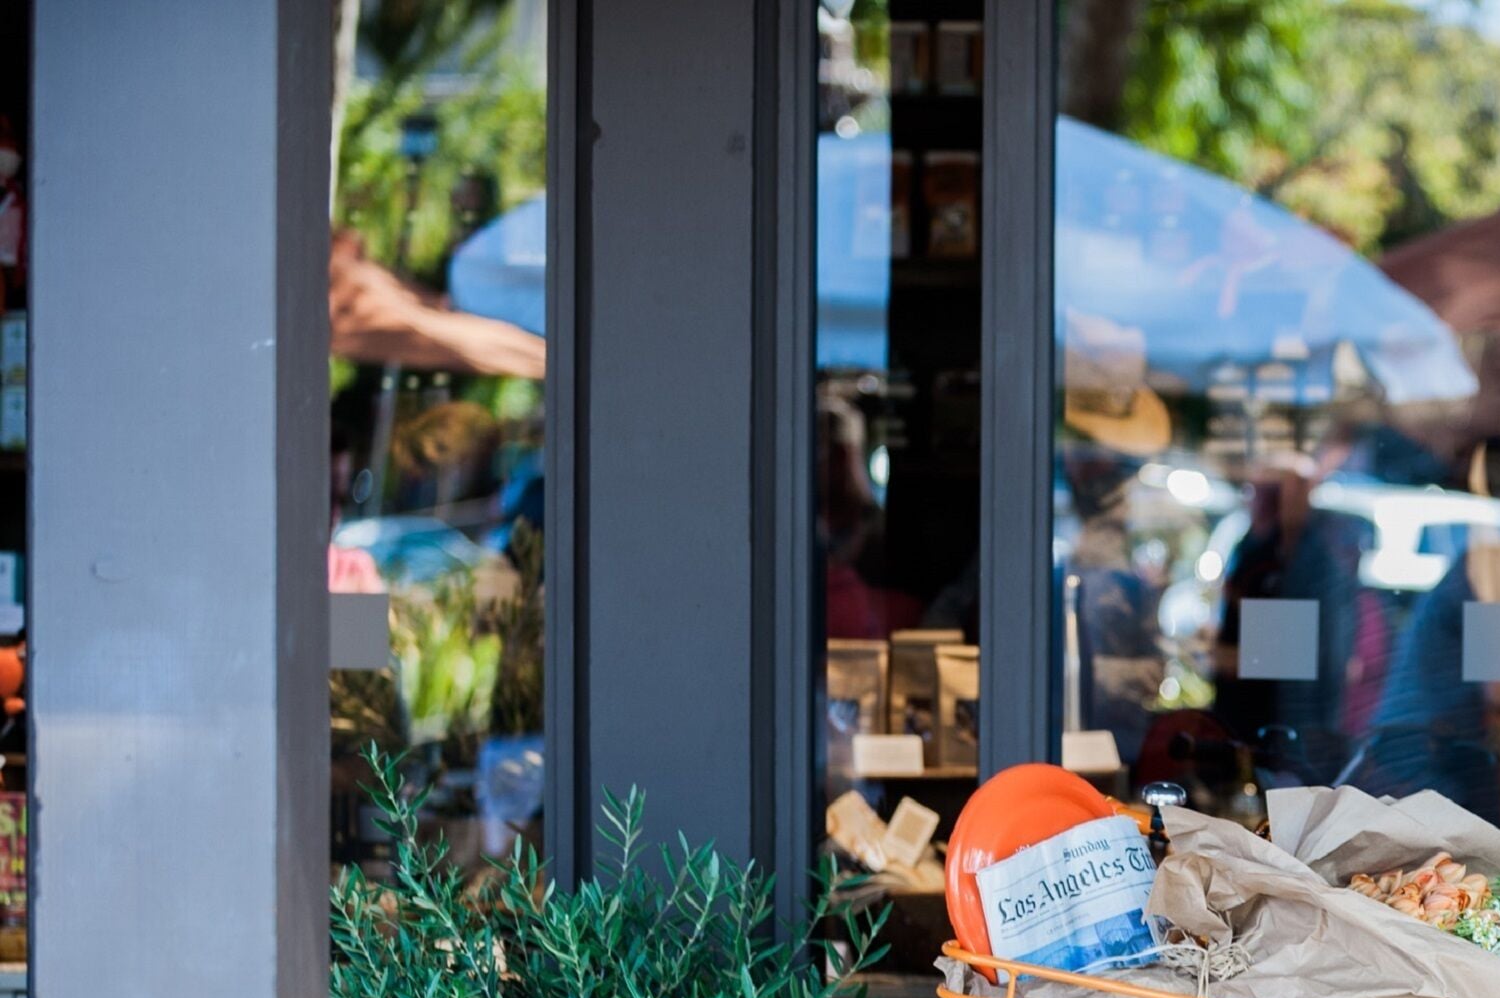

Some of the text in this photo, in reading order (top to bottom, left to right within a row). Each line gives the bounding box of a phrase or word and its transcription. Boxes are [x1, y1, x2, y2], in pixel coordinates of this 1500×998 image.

[1063, 839, 1111, 862] Sunday
[998, 893, 1036, 925] Los
[1038, 857, 1125, 909] Angeles
